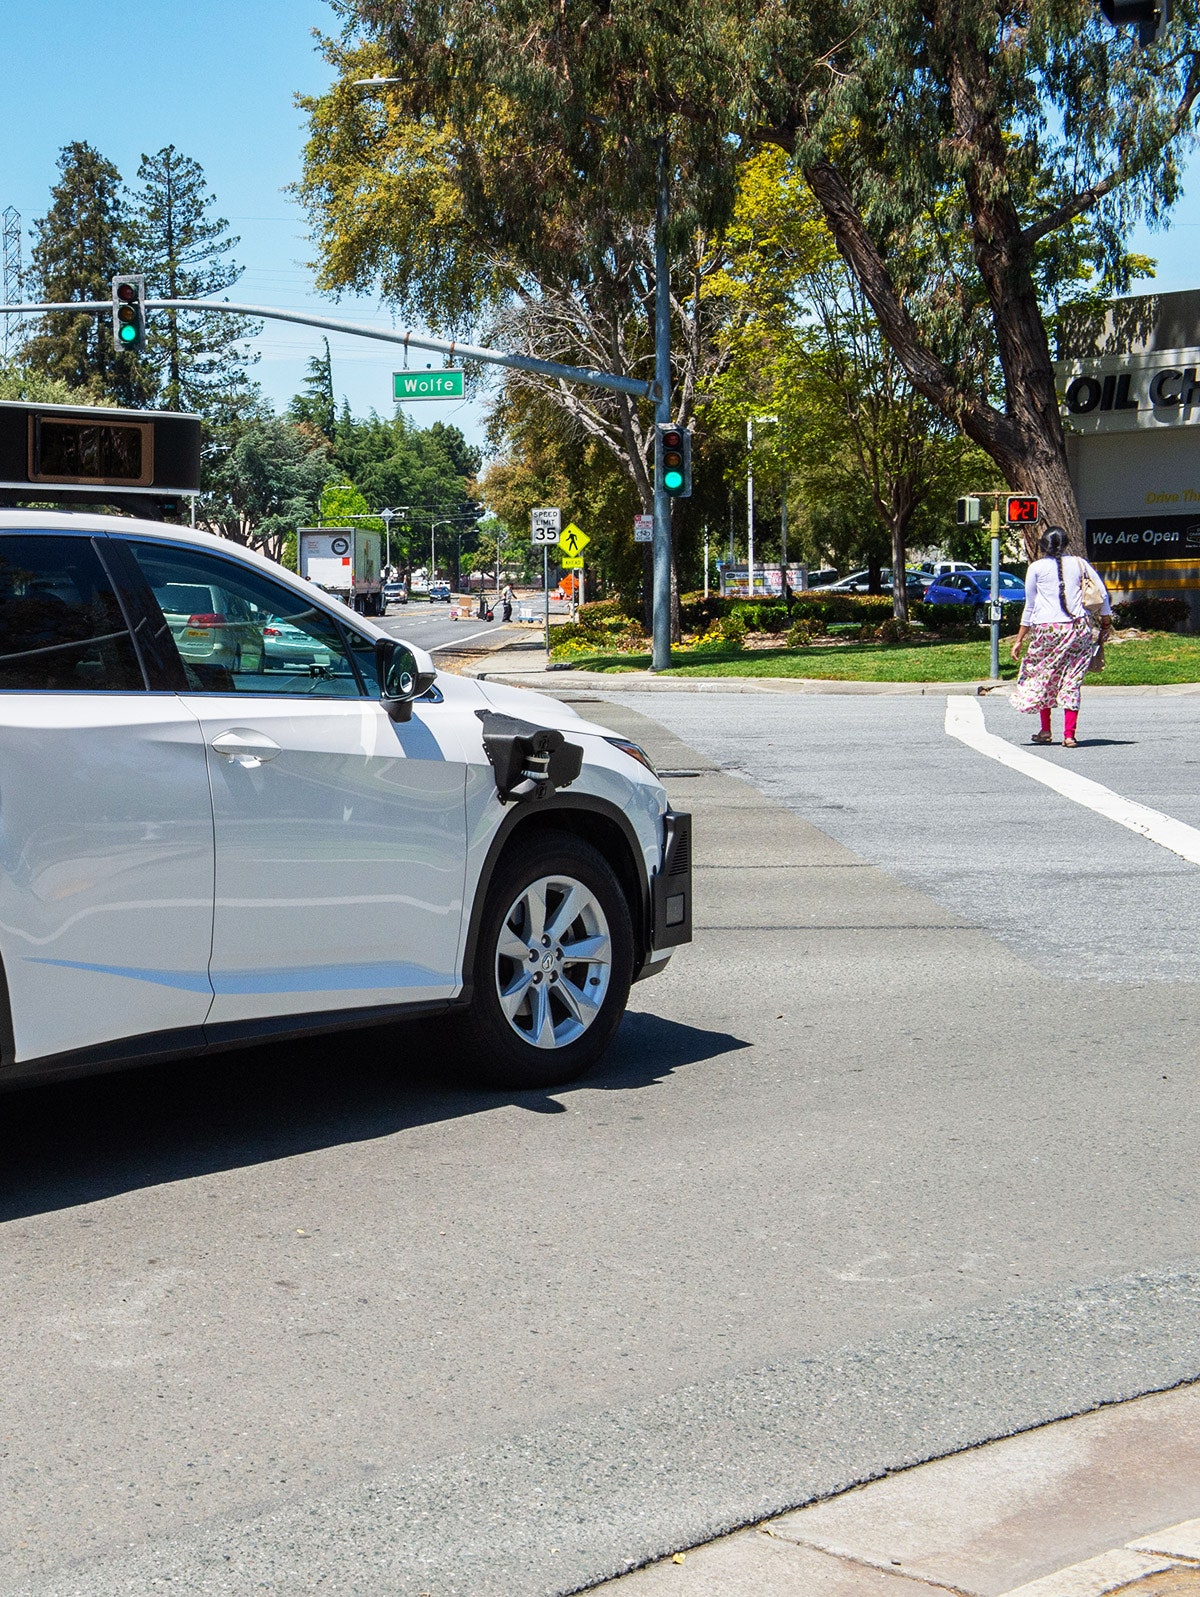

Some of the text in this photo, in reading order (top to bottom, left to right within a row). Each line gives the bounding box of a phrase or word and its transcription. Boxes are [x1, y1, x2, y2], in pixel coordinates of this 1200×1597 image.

[404, 378, 454, 393] Wolfe
[1065, 373, 1139, 415] OIL
[1145, 491, 1179, 505] Drive
[1021, 501, 1037, 519] 27
[535, 527, 557, 540] 35
[1092, 529, 1180, 546] We Are Open
